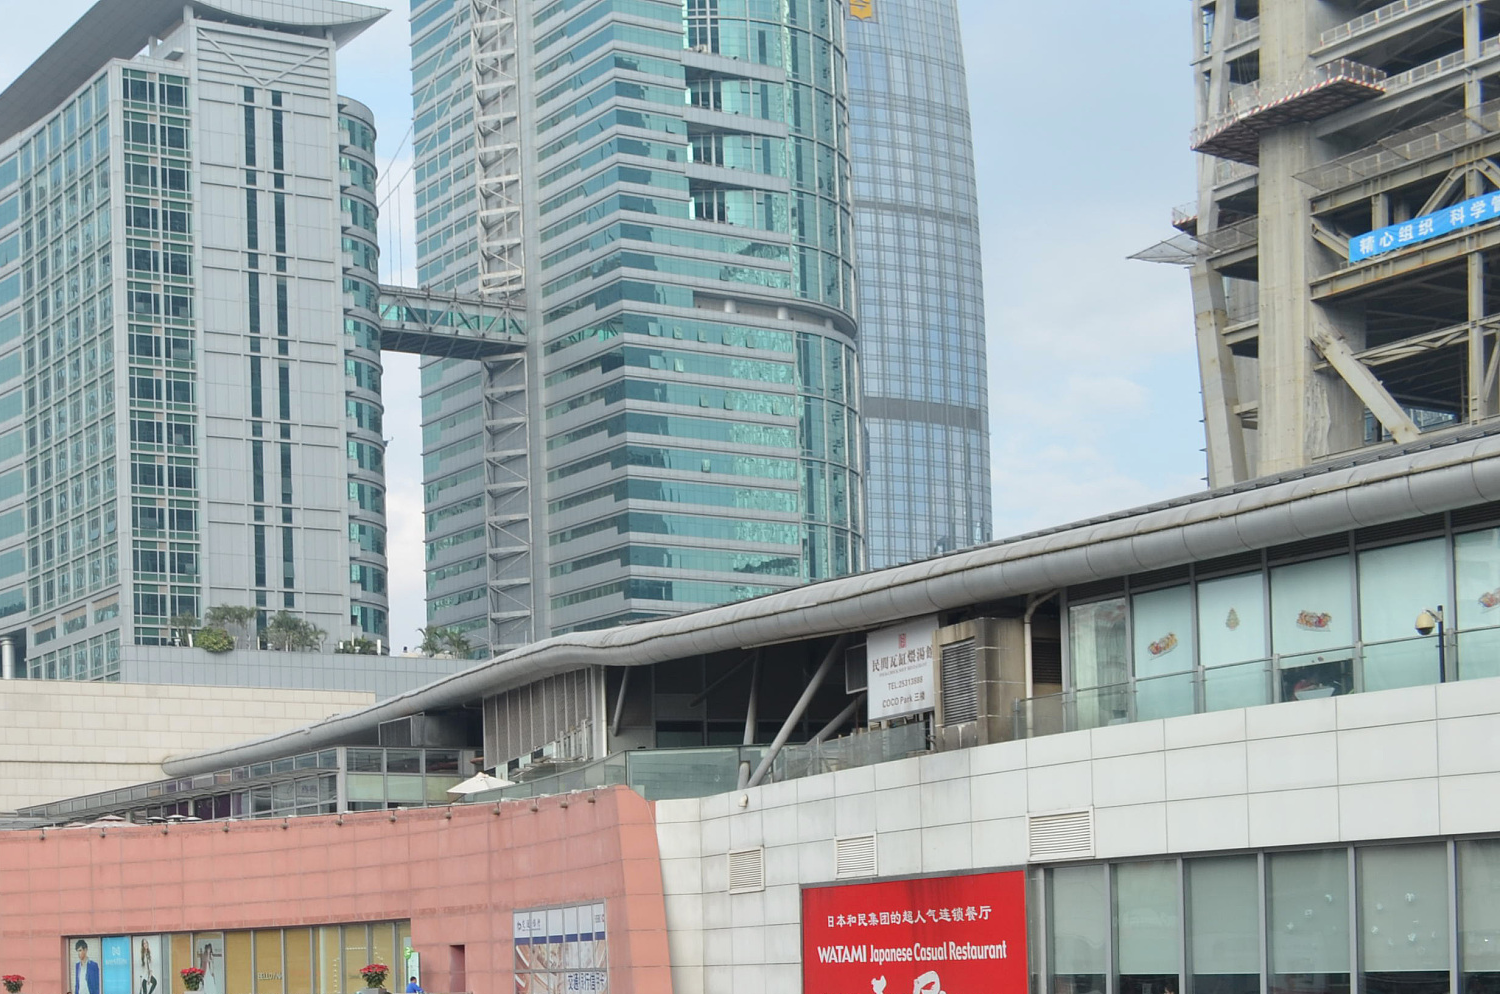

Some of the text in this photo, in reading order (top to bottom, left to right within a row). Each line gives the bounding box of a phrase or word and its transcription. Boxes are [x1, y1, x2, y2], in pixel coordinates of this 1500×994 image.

[1359, 217, 1434, 255] 精心组织
[827, 905, 992, 928] 日本和民集团的超人气连锁餐厅
[817, 940, 1007, 965] WATAMI Japanese Casual Restaurant
